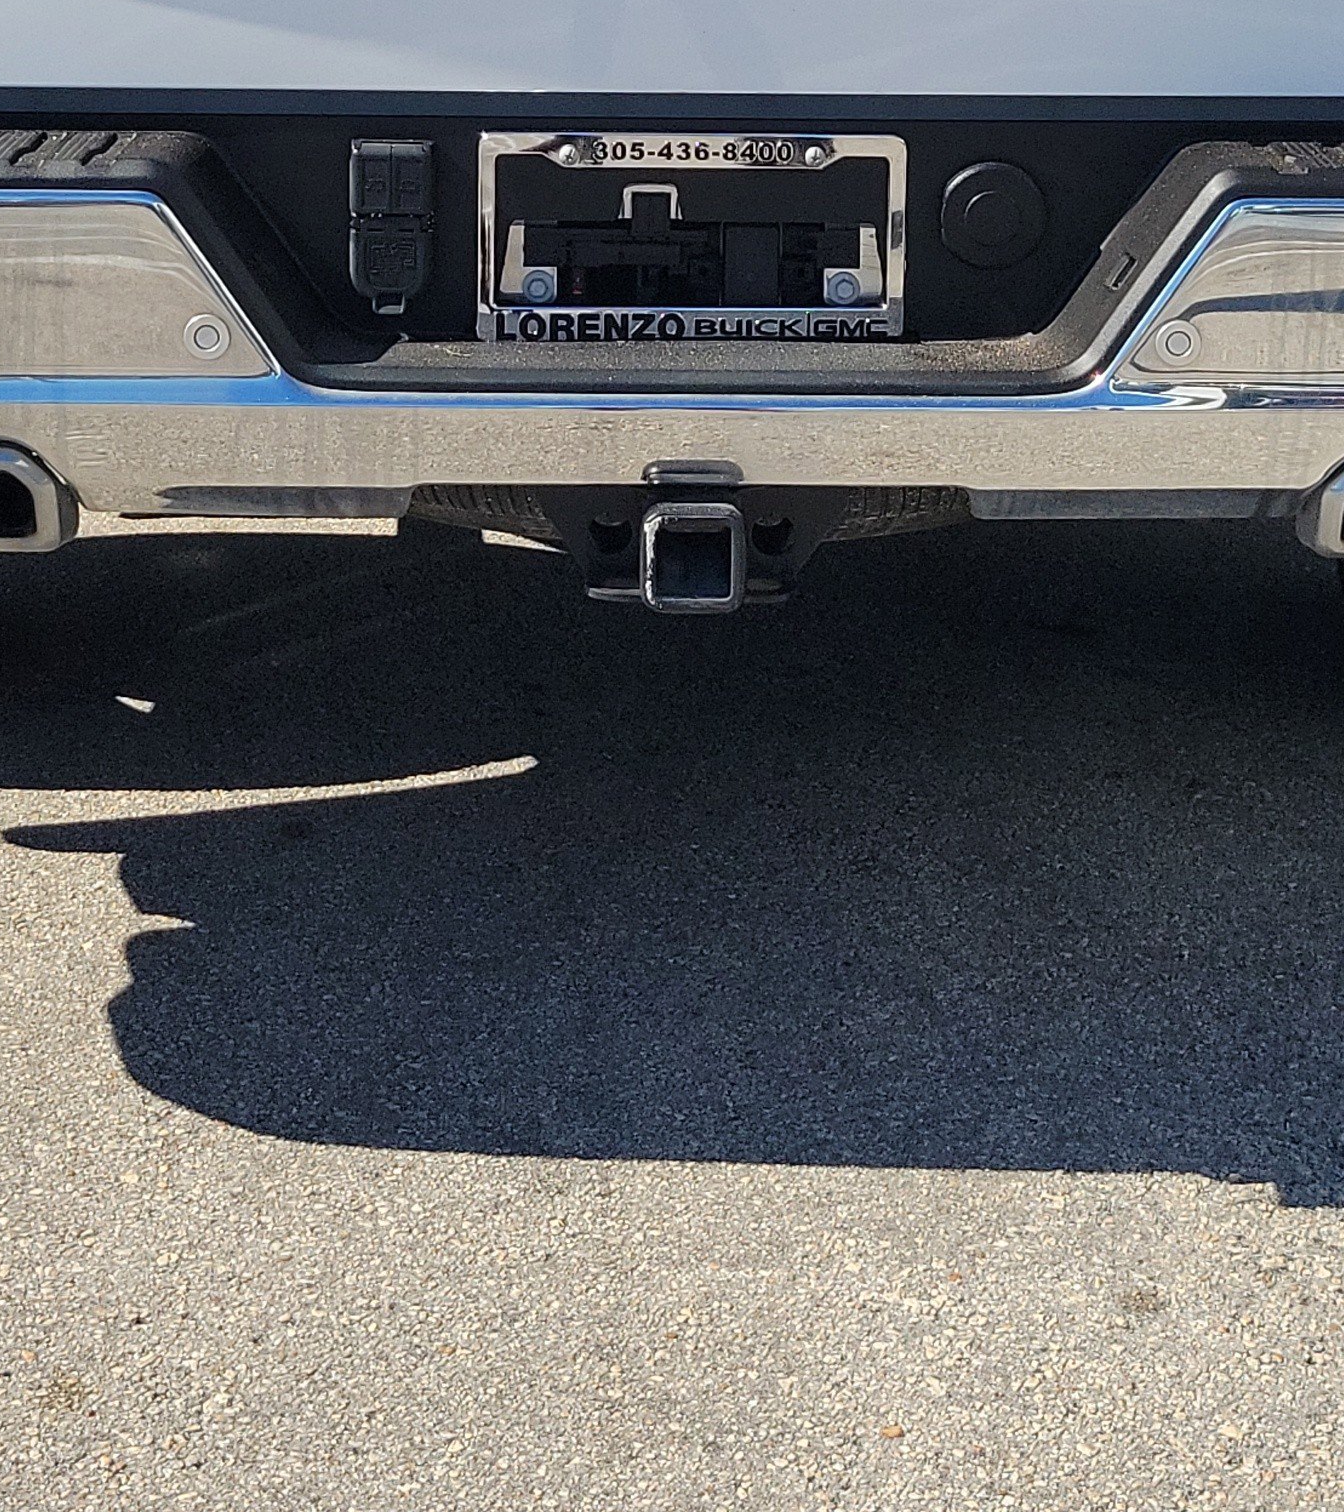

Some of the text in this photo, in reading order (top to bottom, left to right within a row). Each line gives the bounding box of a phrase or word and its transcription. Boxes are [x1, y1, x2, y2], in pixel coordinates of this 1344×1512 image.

[592, 140, 794, 164] 305-436-8400
[494, 312, 889, 342] LORENZO BUICK GMC
